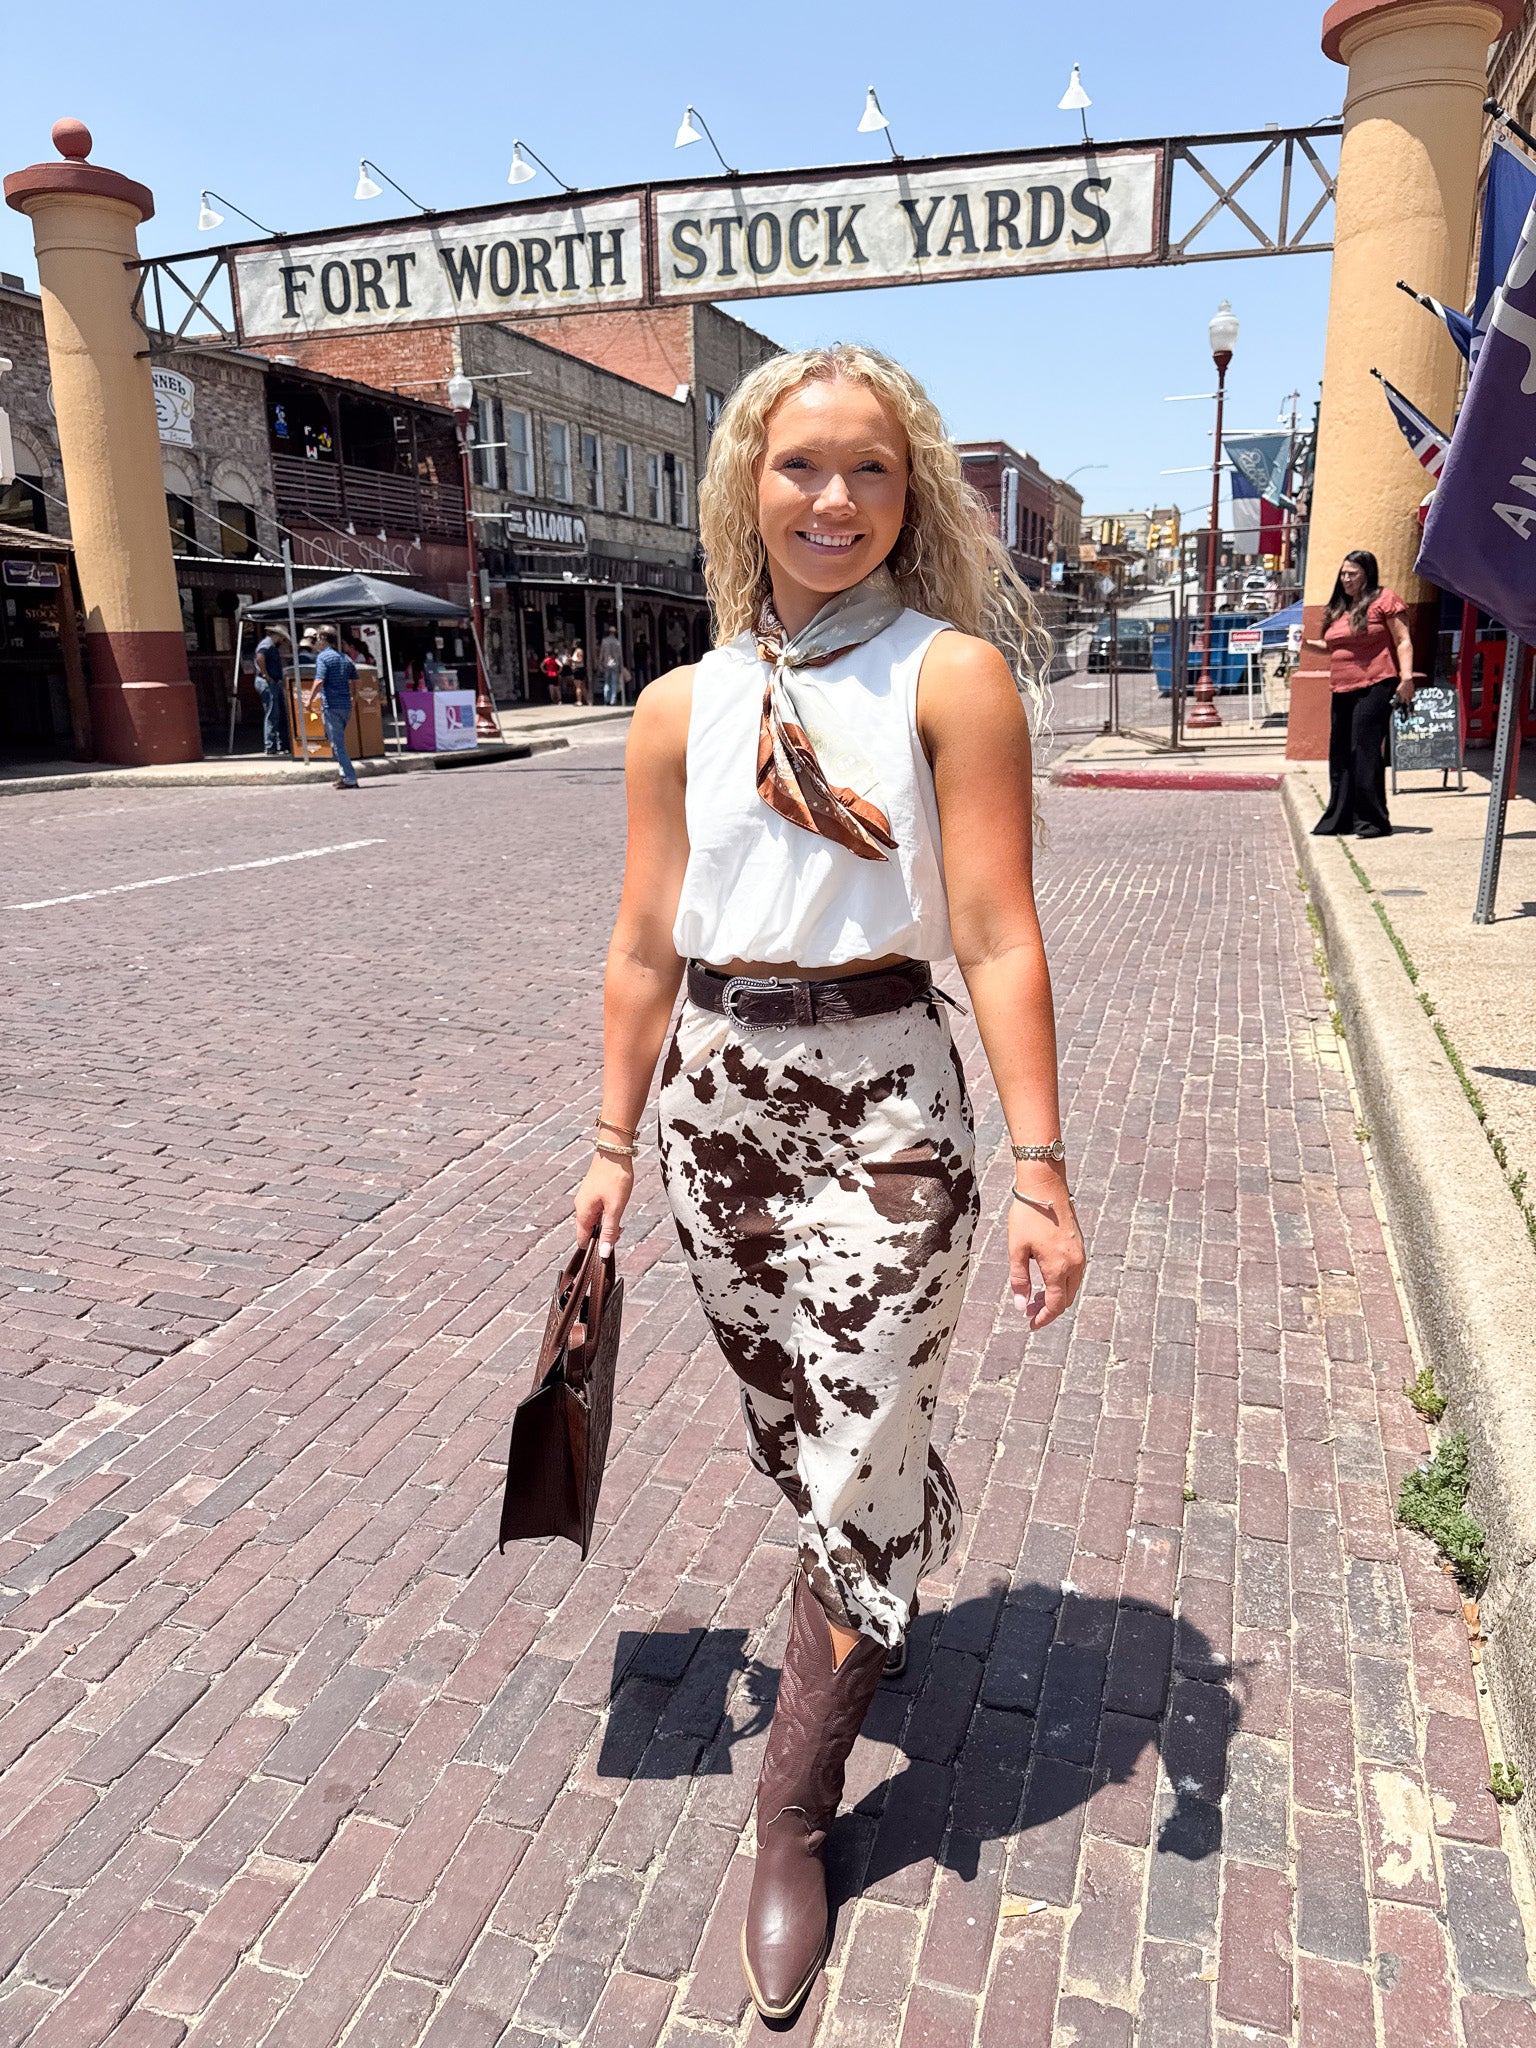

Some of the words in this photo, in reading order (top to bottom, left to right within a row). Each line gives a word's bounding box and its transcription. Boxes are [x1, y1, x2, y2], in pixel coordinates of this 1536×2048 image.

[672, 204, 869, 280] STOCK
[899, 176, 1112, 259] YARDS
[279, 252, 416, 319] FORT
[439, 228, 627, 304] WORTH
[358, 541, 415, 574] SHACK
[526, 509, 574, 544] SALOON
